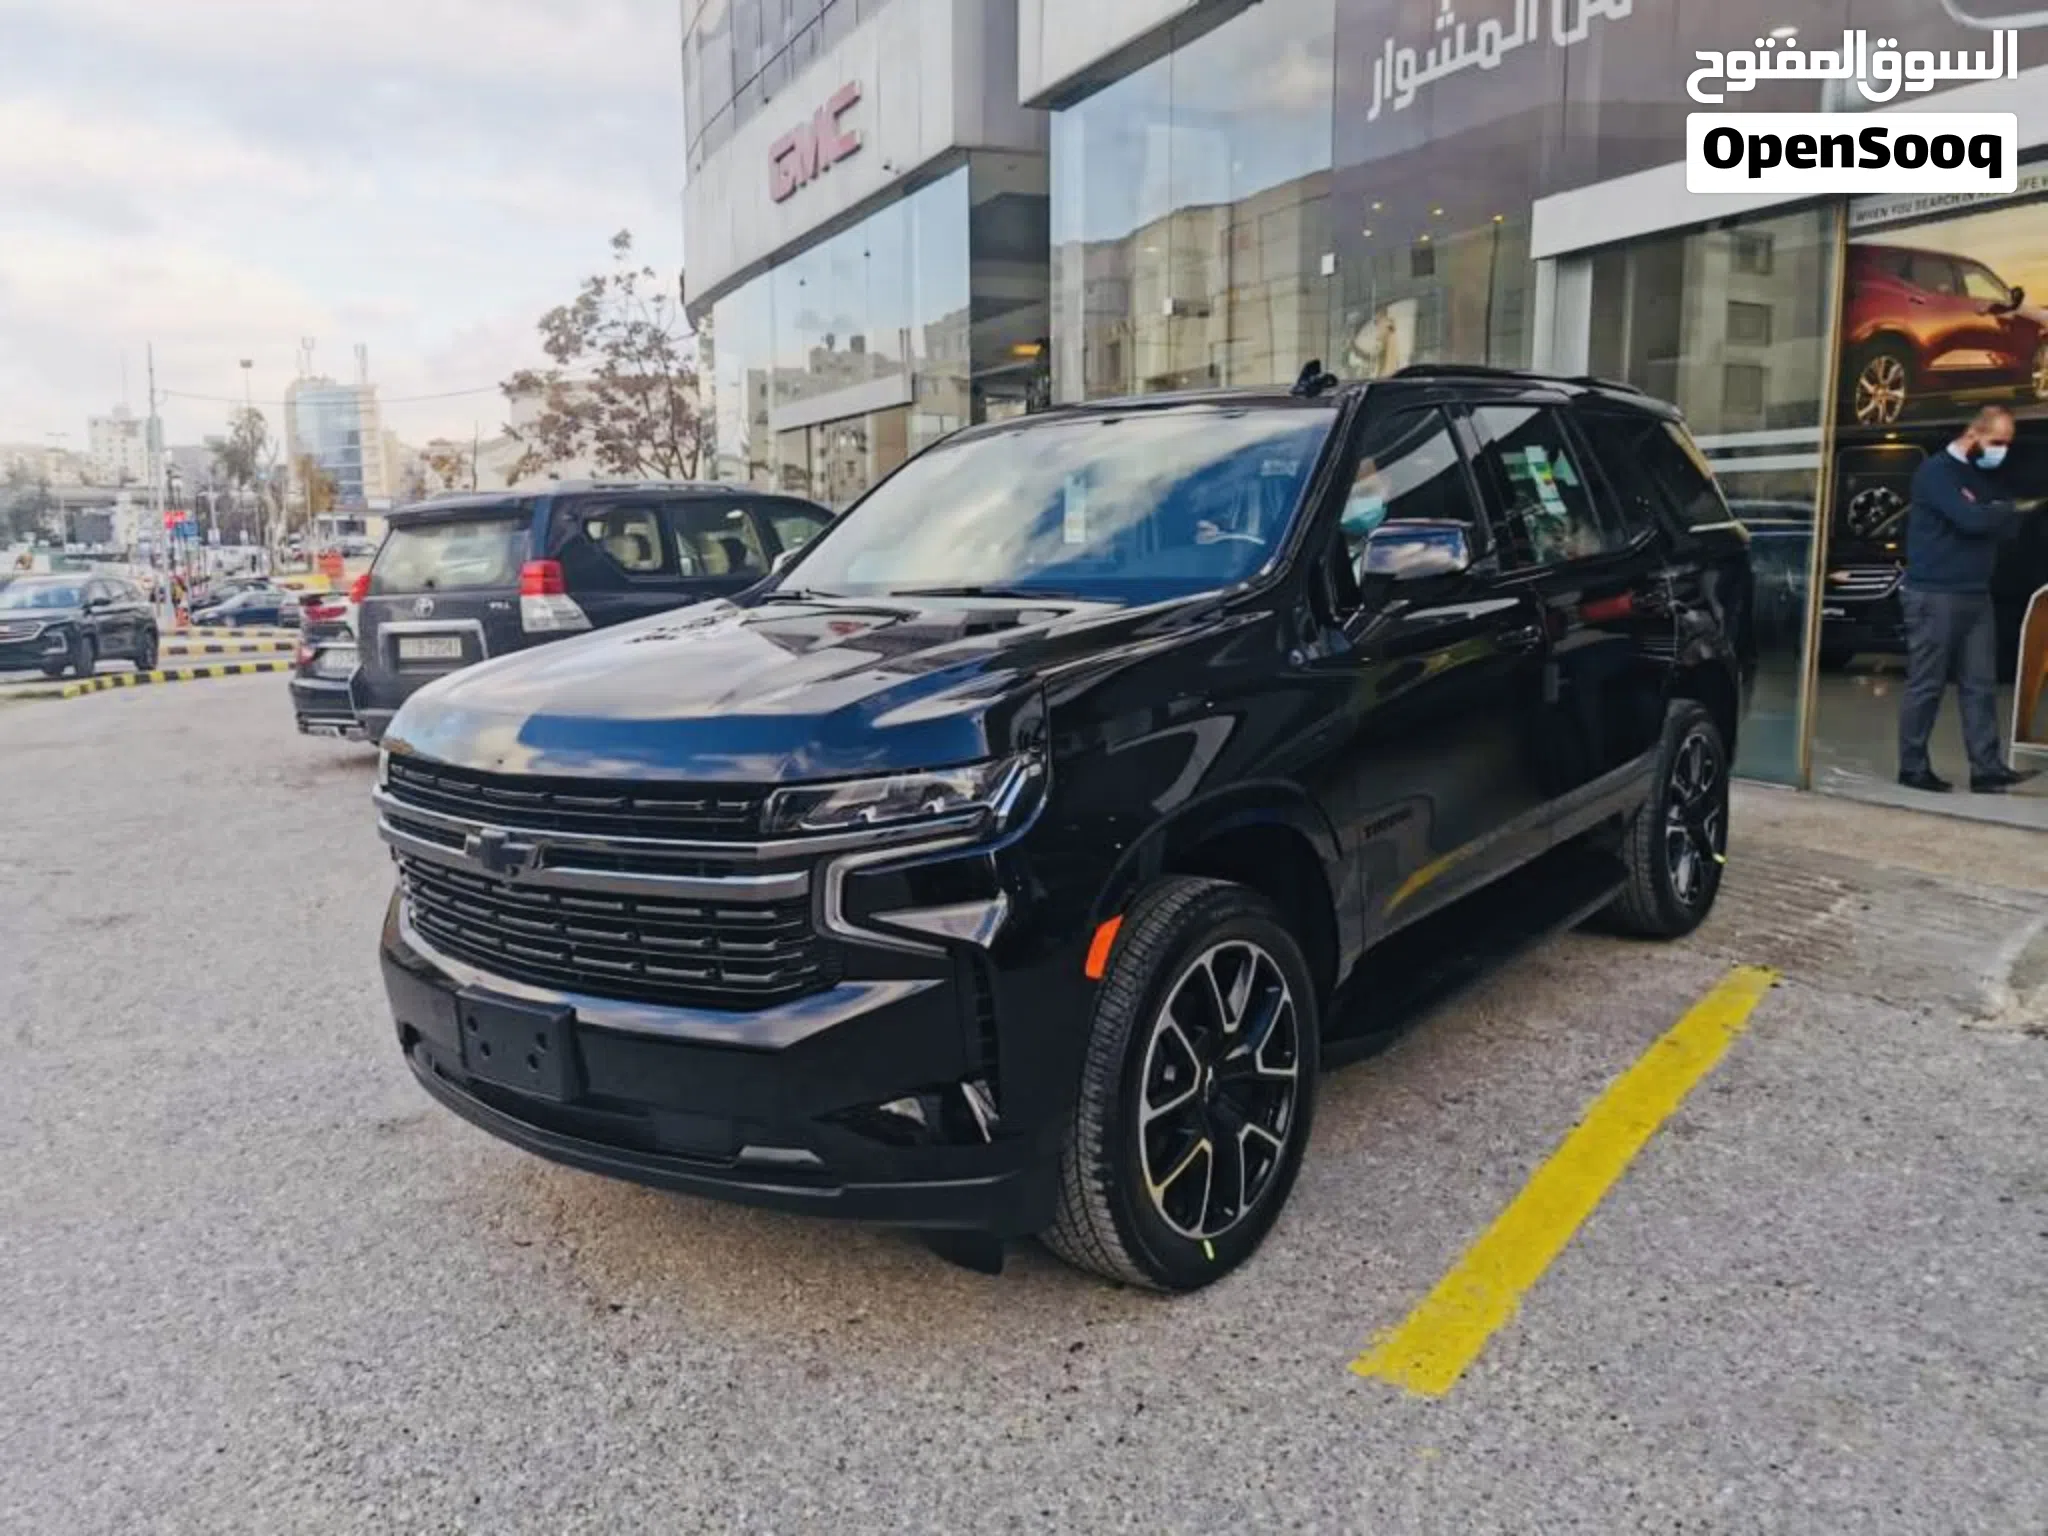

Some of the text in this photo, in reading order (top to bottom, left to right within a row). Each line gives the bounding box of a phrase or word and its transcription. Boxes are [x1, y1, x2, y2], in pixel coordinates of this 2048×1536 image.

[1367, 0, 1538, 122] المشوار
[767, 80, 862, 204] GMC
[1856, 207, 1889, 222] WHEN
[1914, 193, 1961, 211] SEARCH
[2017, 175, 2041, 191] IFE
